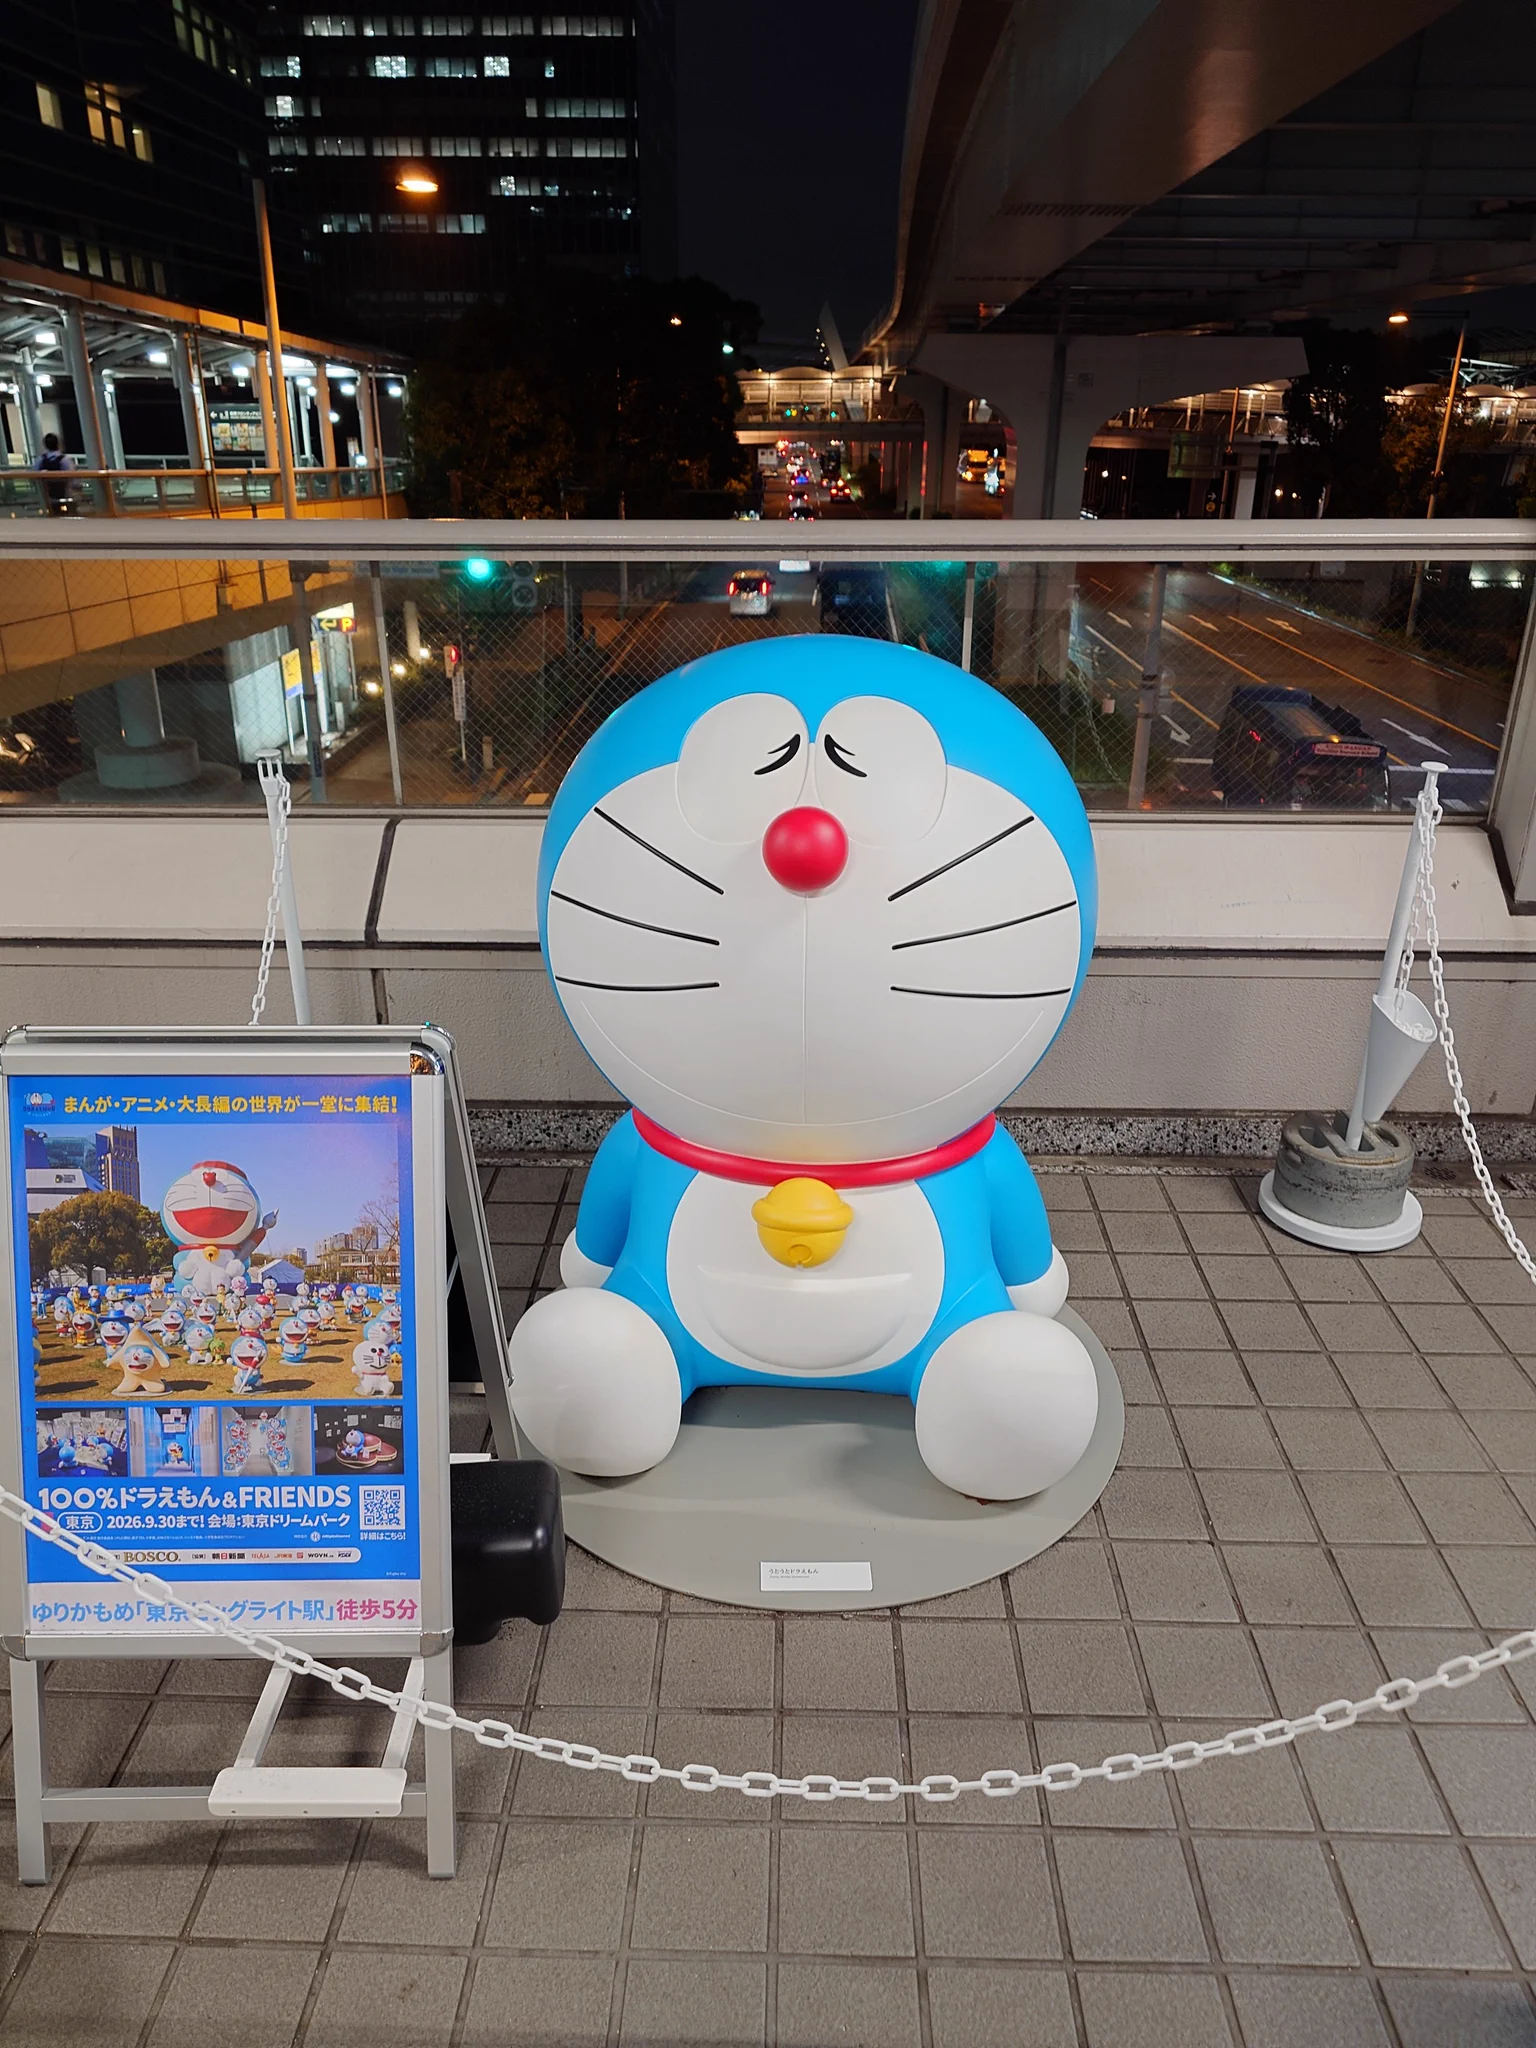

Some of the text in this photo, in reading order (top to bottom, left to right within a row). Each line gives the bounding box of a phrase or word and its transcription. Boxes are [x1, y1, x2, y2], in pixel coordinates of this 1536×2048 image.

[341, 618, 353, 632] P
[64, 1095, 398, 1114] まんが・アニメ・大長編の世界が一堂に集結!
[38, 1485, 352, 1510] 100%ドラえもん&FRIENDS
[65, 1513, 351, 1529] 東京 2026.9.30まで! 会場:東京ドリームパーク
[360, 1532, 406, 1541] 詳細はこちら!
[212, 1552, 246, 1560] 朝日新聞
